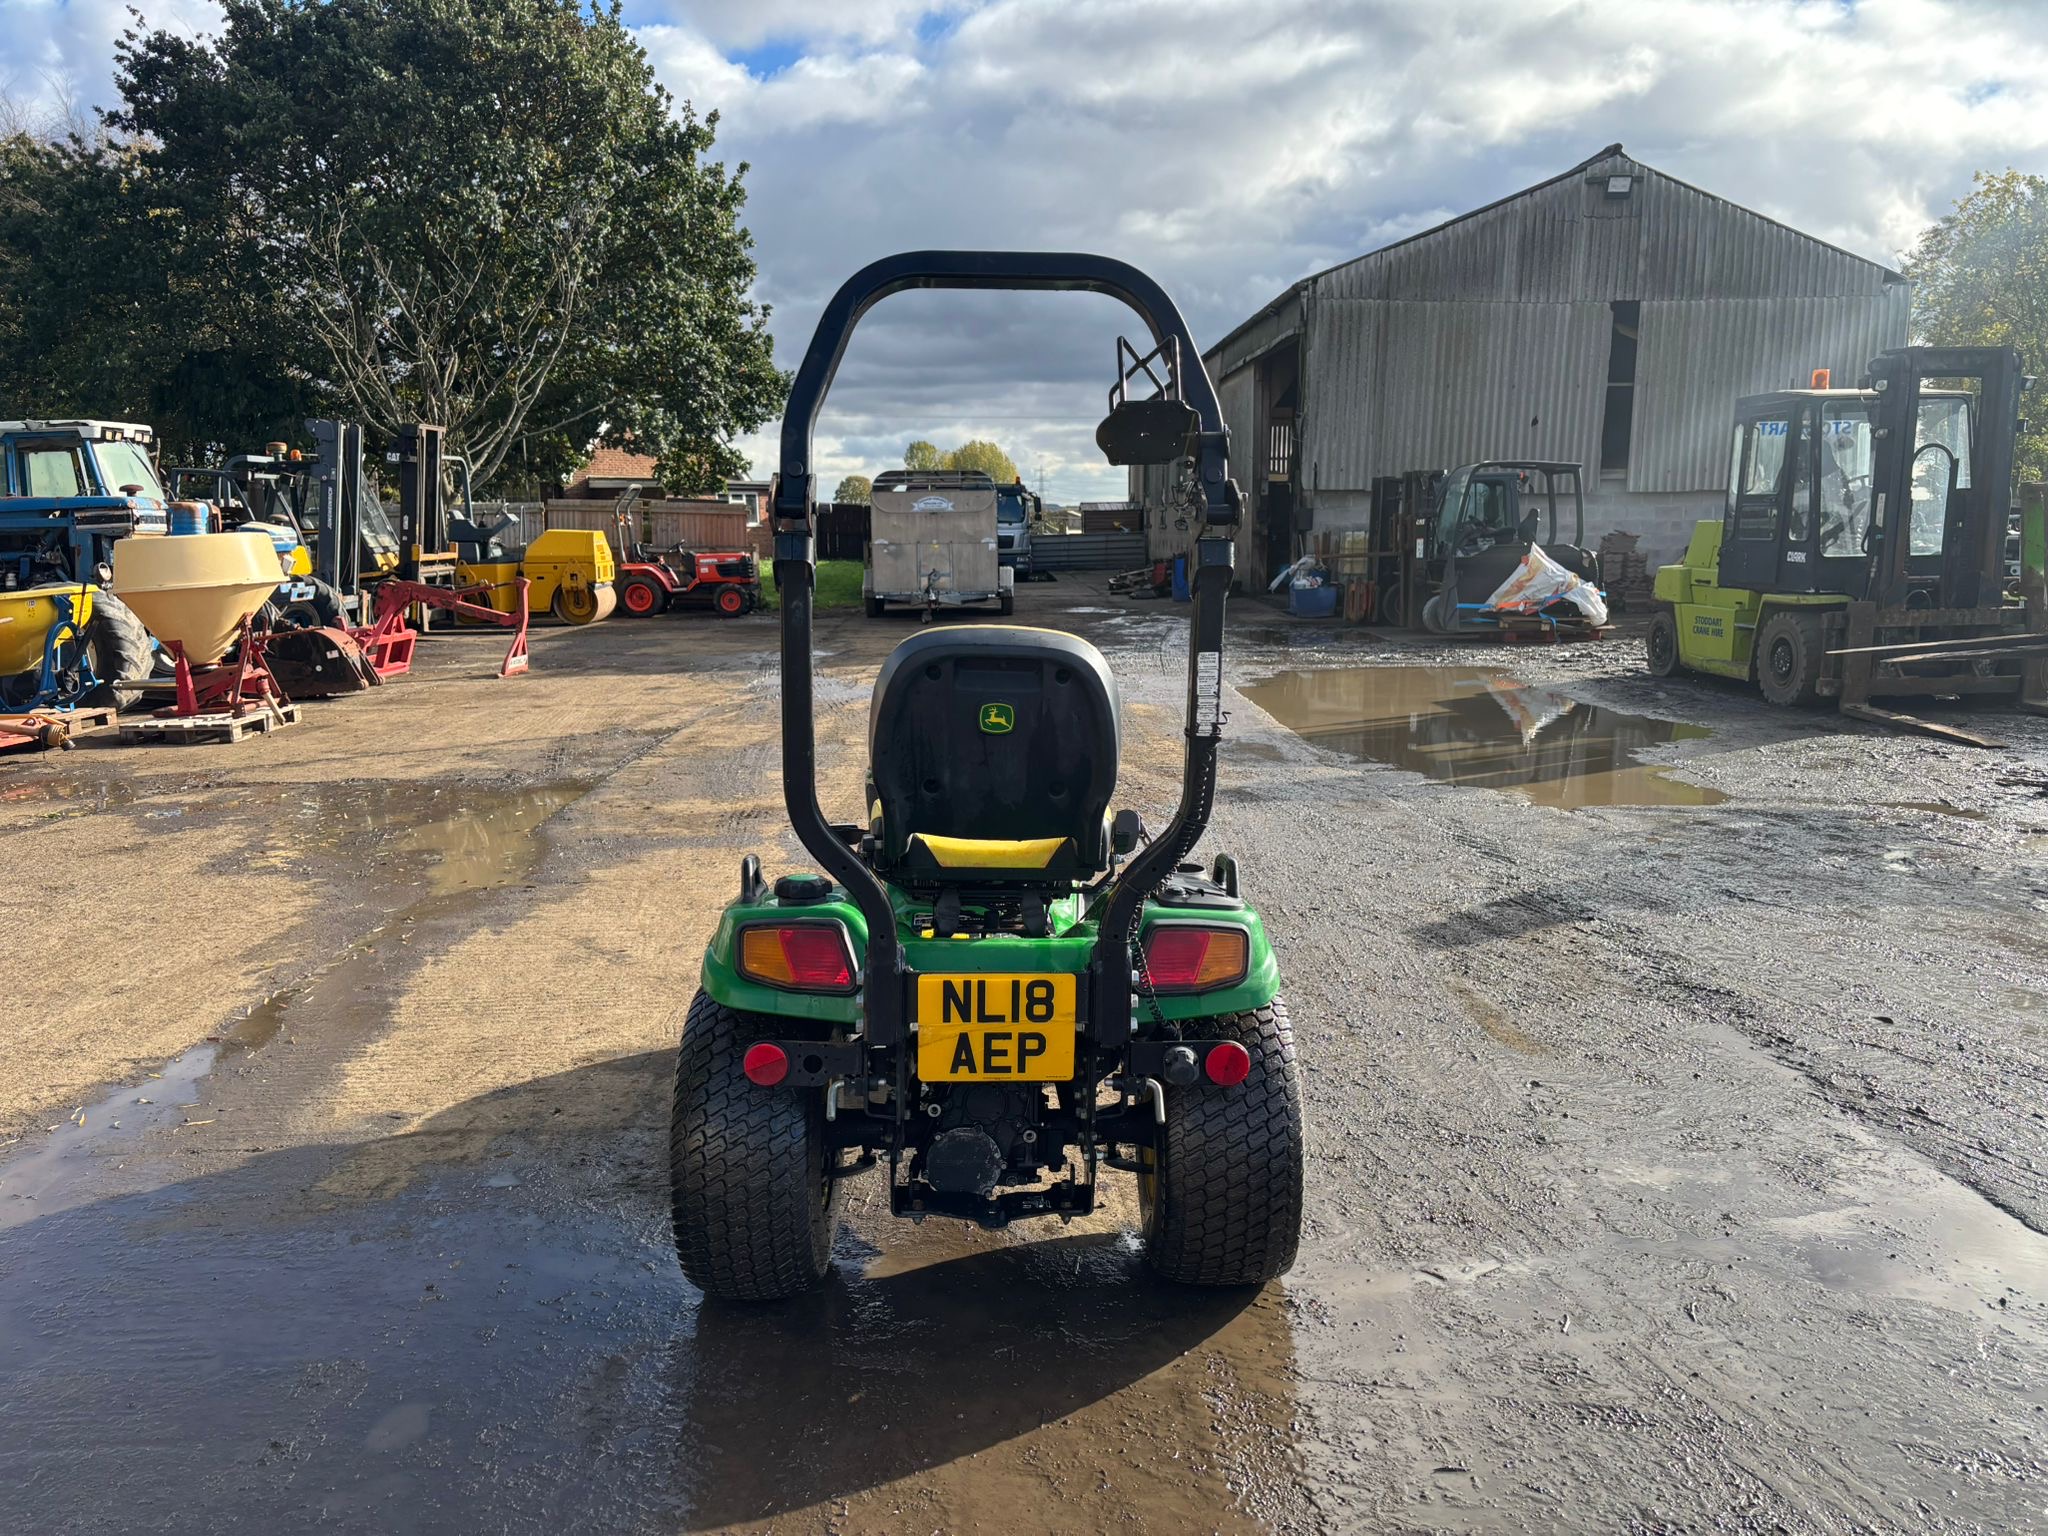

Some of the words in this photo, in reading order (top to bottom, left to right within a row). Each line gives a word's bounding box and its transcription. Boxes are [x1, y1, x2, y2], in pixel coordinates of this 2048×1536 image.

[387, 452, 400, 461] CAT
[1695, 615, 1722, 627] STODDART
[1693, 625, 1710, 636] CRANE
[1711, 627, 1724, 638] HIRE
[943, 980, 1054, 1023] NL18
[950, 1032, 1047, 1074] AEP
